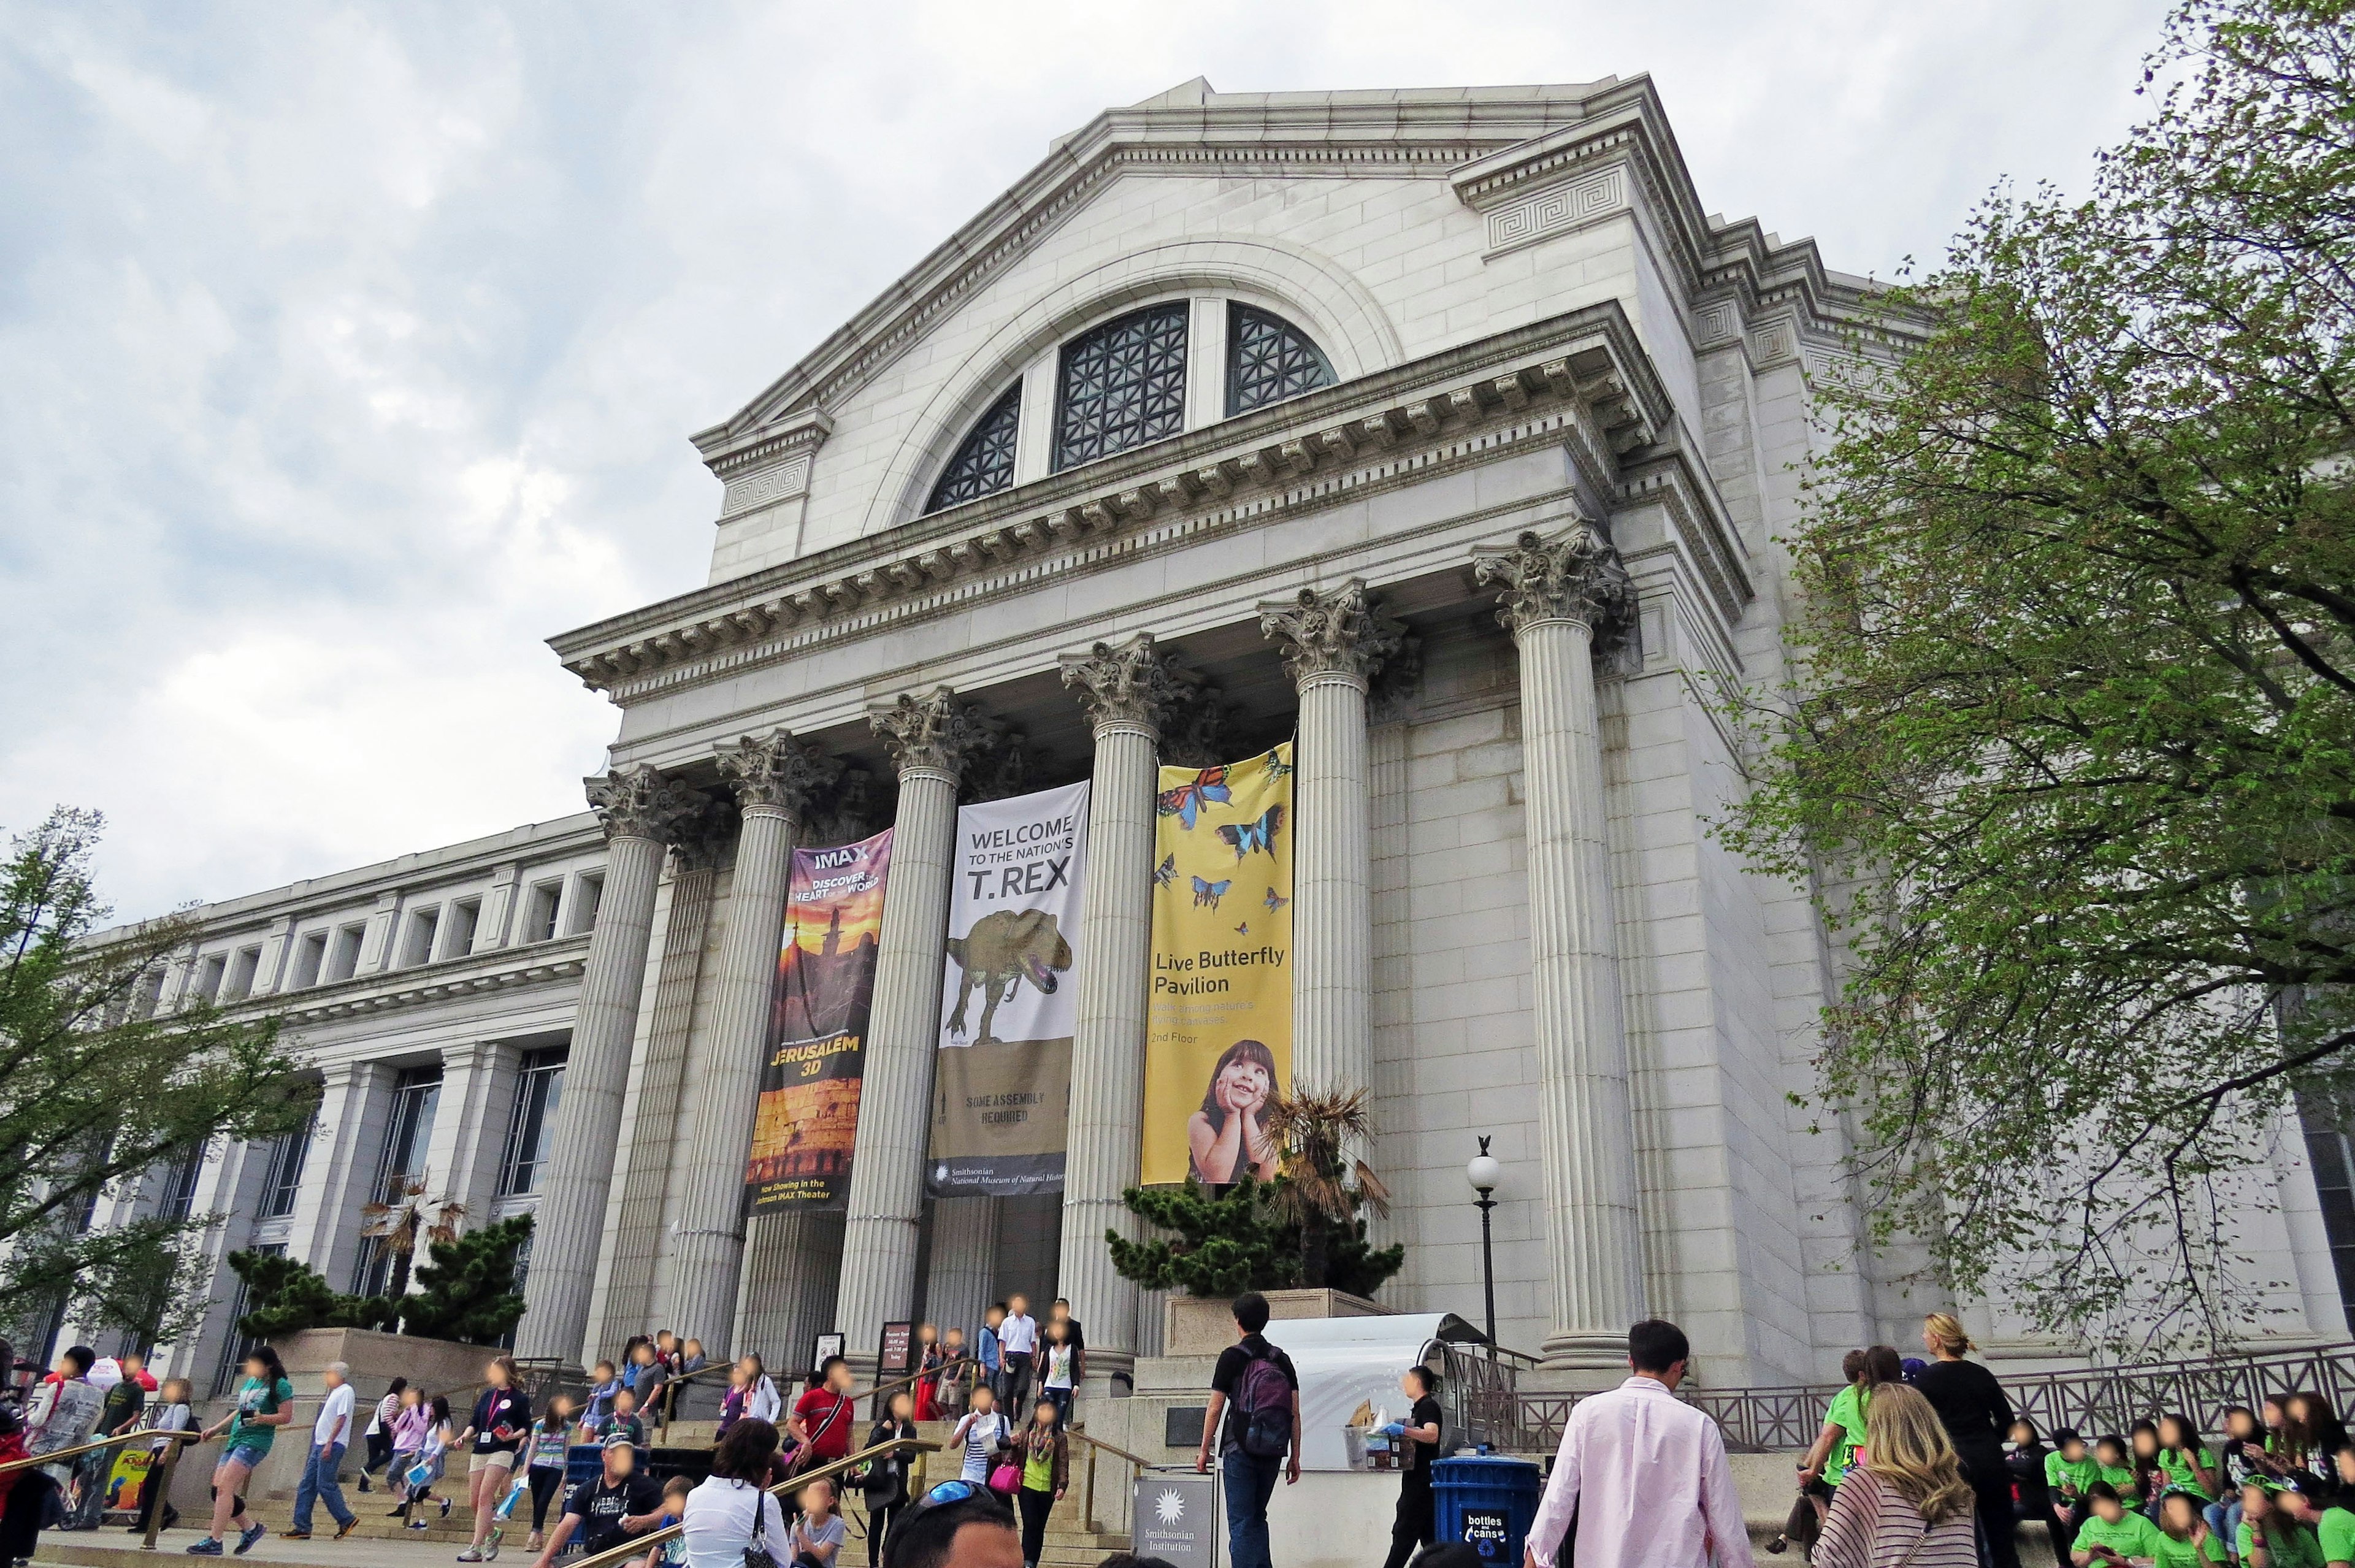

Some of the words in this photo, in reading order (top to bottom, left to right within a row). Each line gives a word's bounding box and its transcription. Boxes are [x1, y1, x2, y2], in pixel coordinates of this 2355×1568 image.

[971, 815, 1073, 849] WELCOME
[814, 845, 869, 870] IMAX
[969, 854, 986, 865] TO
[989, 851, 1013, 864] THE
[1016, 837, 1073, 860] NATION'S
[812, 871, 865, 890] DISCOVER
[794, 889, 830, 902] HEART
[847, 876, 879, 893] WORLD
[1156, 952, 1193, 971] Live
[1199, 946, 1285, 969] Butterfly
[1155, 976, 1229, 995] Pavilion
[1153, 1001, 1176, 1011] Walk
[1179, 1003, 1211, 1014] among
[1213, 1000, 1254, 1011] nature's
[1152, 1015, 1178, 1026] flying
[1151, 1032, 1169, 1042] 2nd
[1171, 1032, 1198, 1043] Floor
[770, 1036, 860, 1066] JERUSALEM
[800, 1059, 822, 1077] 3D
[966, 1094, 992, 1107] SOME
[993, 1092, 1045, 1106] ASSEMBLY
[981, 1110, 1028, 1124] REQUIRED
[951, 1168, 994, 1176] Smithsonian
[951, 1176, 979, 1185] National
[981, 1176, 1010, 1184] Museum
[1011, 1175, 1019, 1184] of
[1019, 1173, 1045, 1183] Natural
[760, 1185, 773, 1194] Now
[772, 1180, 799, 1192] Showing
[810, 1179, 825, 1188] the
[777, 1191, 795, 1201] IMAX
[797, 1190, 830, 1199] Theater
[1468, 1515, 1502, 1526] bottles
[1144, 1529, 1195, 1540] Smithsonian
[1474, 1529, 1498, 1539] cans
[1149, 1540, 1192, 1552] Institution
